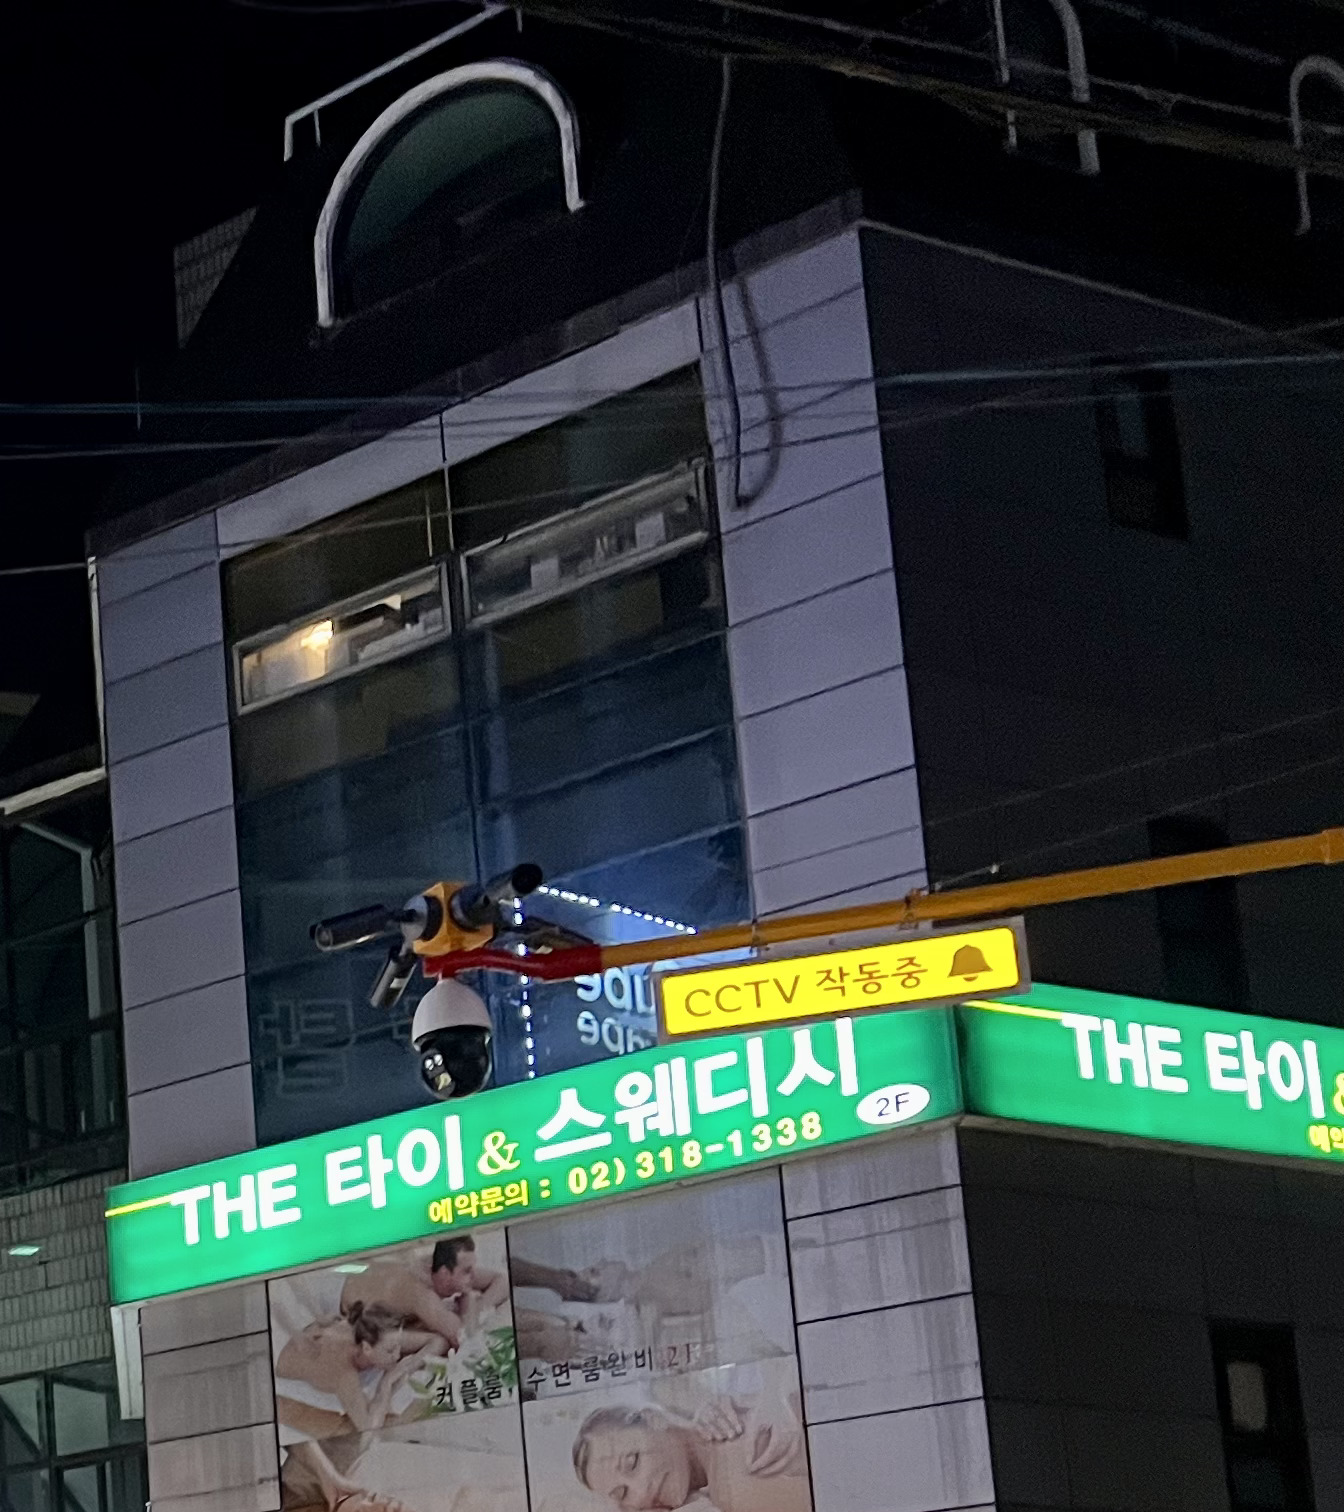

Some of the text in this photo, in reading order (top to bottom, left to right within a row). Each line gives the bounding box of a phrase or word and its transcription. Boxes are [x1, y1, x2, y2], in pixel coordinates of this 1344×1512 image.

[684, 956, 929, 1020] CCTV 작동중
[1062, 1011, 1325, 1119] THE 타이
[171, 1162, 302, 1247] THE
[325, 1113, 466, 1211] 타이
[476, 1130, 521, 1177] &
[533, 1016, 860, 1165] 스웨디시
[875, 1094, 910, 1119] 2F
[427, 1184, 530, 1226] 예약문의
[435, 1366, 504, 1409] 커플룸
